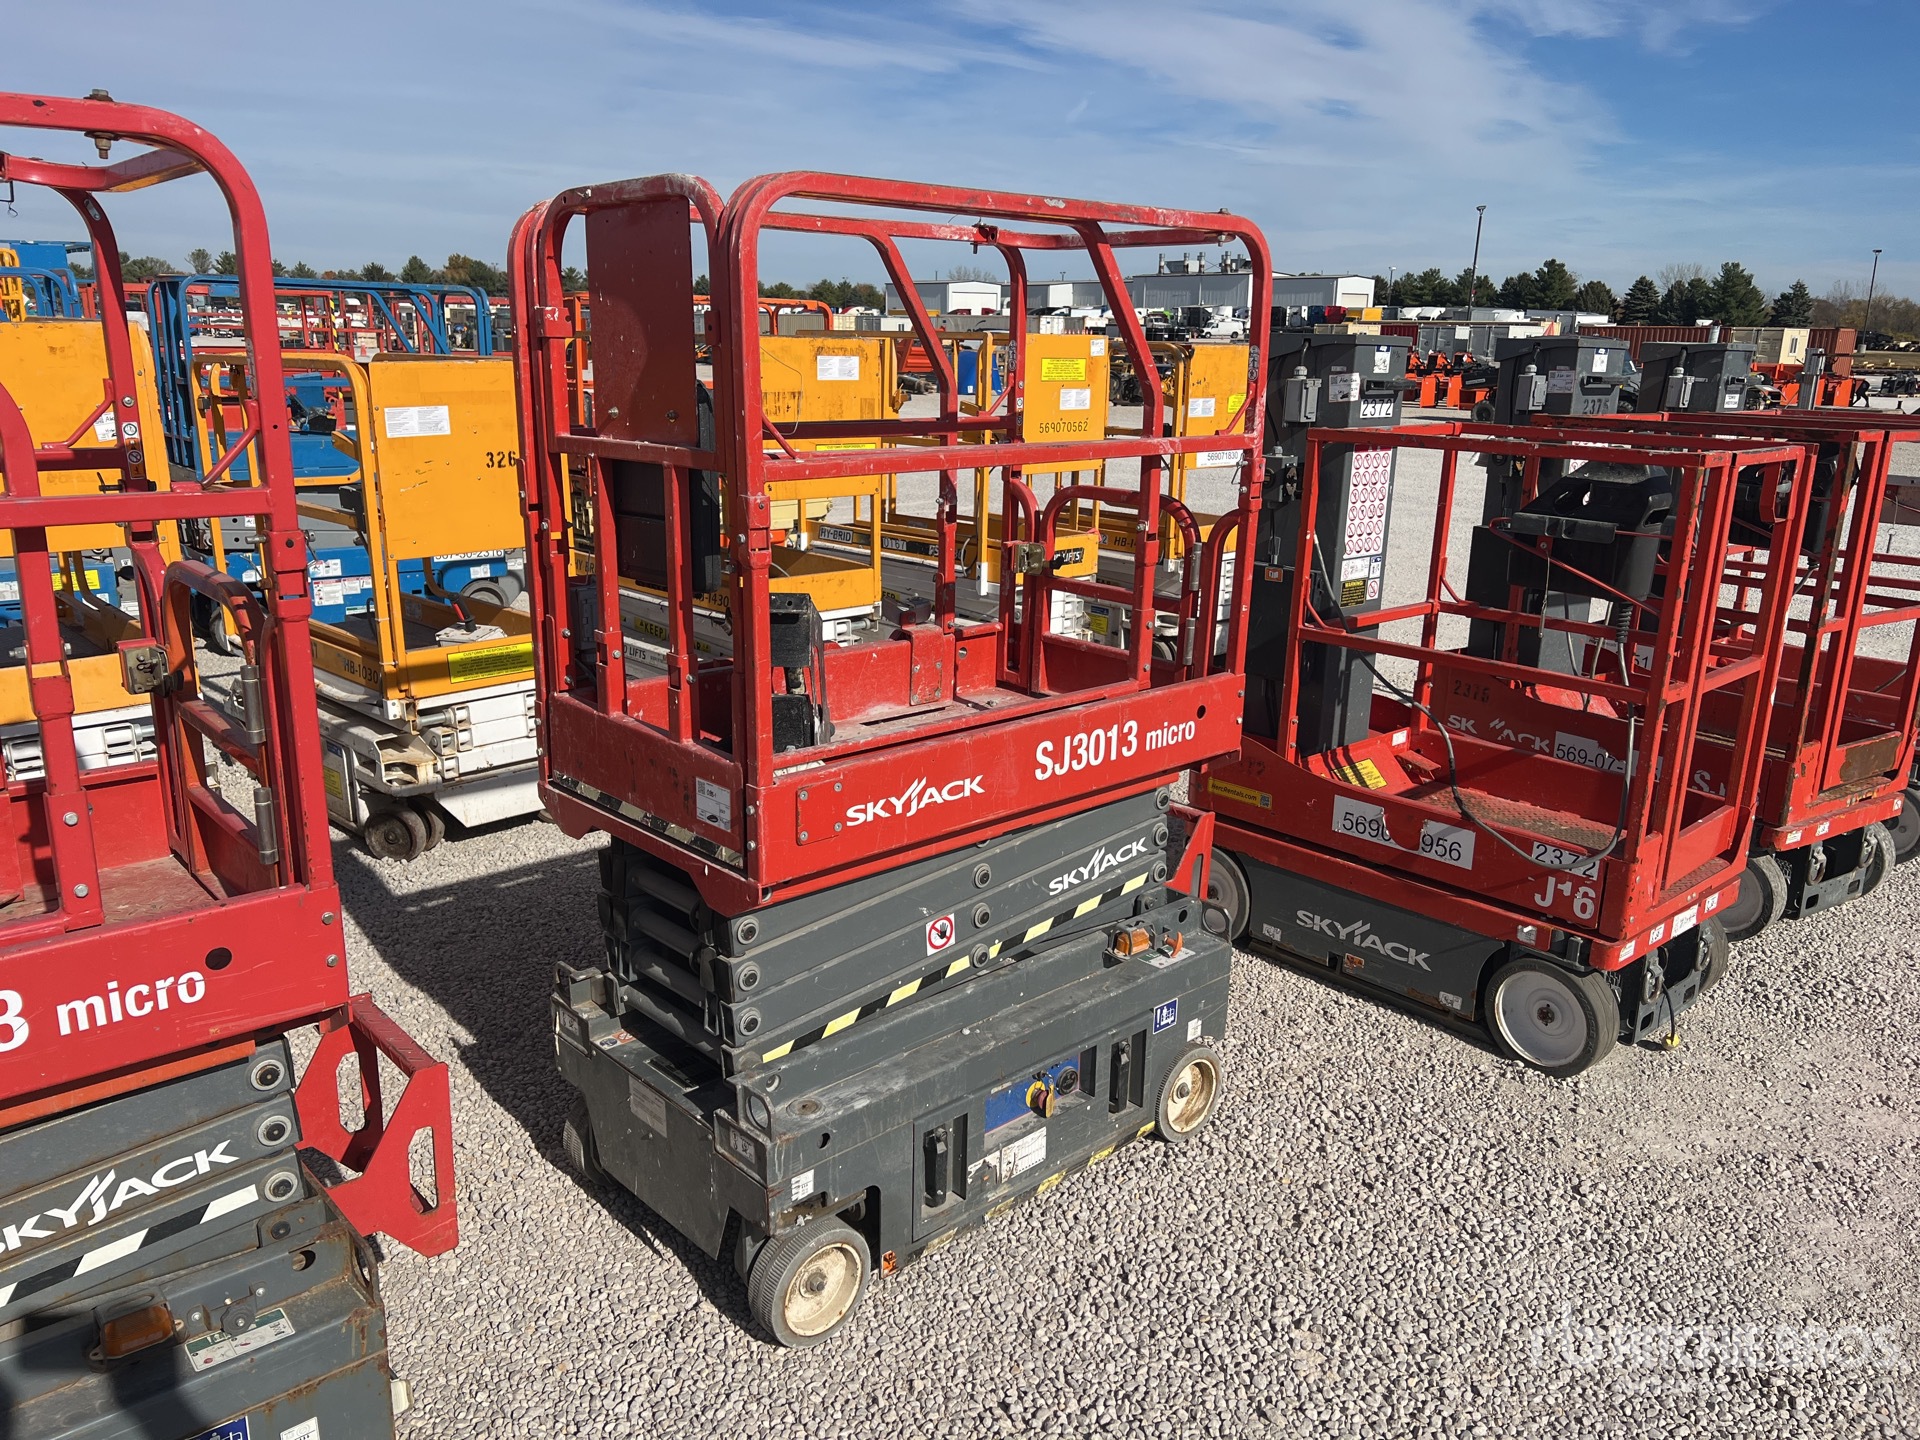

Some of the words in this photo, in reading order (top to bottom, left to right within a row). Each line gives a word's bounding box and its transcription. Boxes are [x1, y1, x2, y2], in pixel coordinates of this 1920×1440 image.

[1362, 399, 1392, 416] 2372
[1039, 421, 1088, 433] 569070562
[486, 450, 516, 468] 326
[1207, 451, 1239, 461] 569071830
[820, 527, 852, 543] HY-BRID
[1114, 536, 1137, 548] HB-1
[644, 623, 664, 638] KEEP
[629, 646, 646, 660] LIFTS
[344, 659, 379, 684] HB-1030
[1034, 720, 1138, 781] SJ3013
[1145, 720, 1195, 751] micro
[1556, 743, 1624, 771] 569-07-
[846, 774, 985, 827] SKYJACK
[1211, 783, 1257, 802] HercRentals.com
[1048, 836, 1148, 896] SKYJACK
[1535, 844, 1596, 878] 2372
[1296, 909, 1432, 972] SKYJACK
[56, 971, 206, 1036] micro
[0, 1139, 240, 1251] KYJACK
